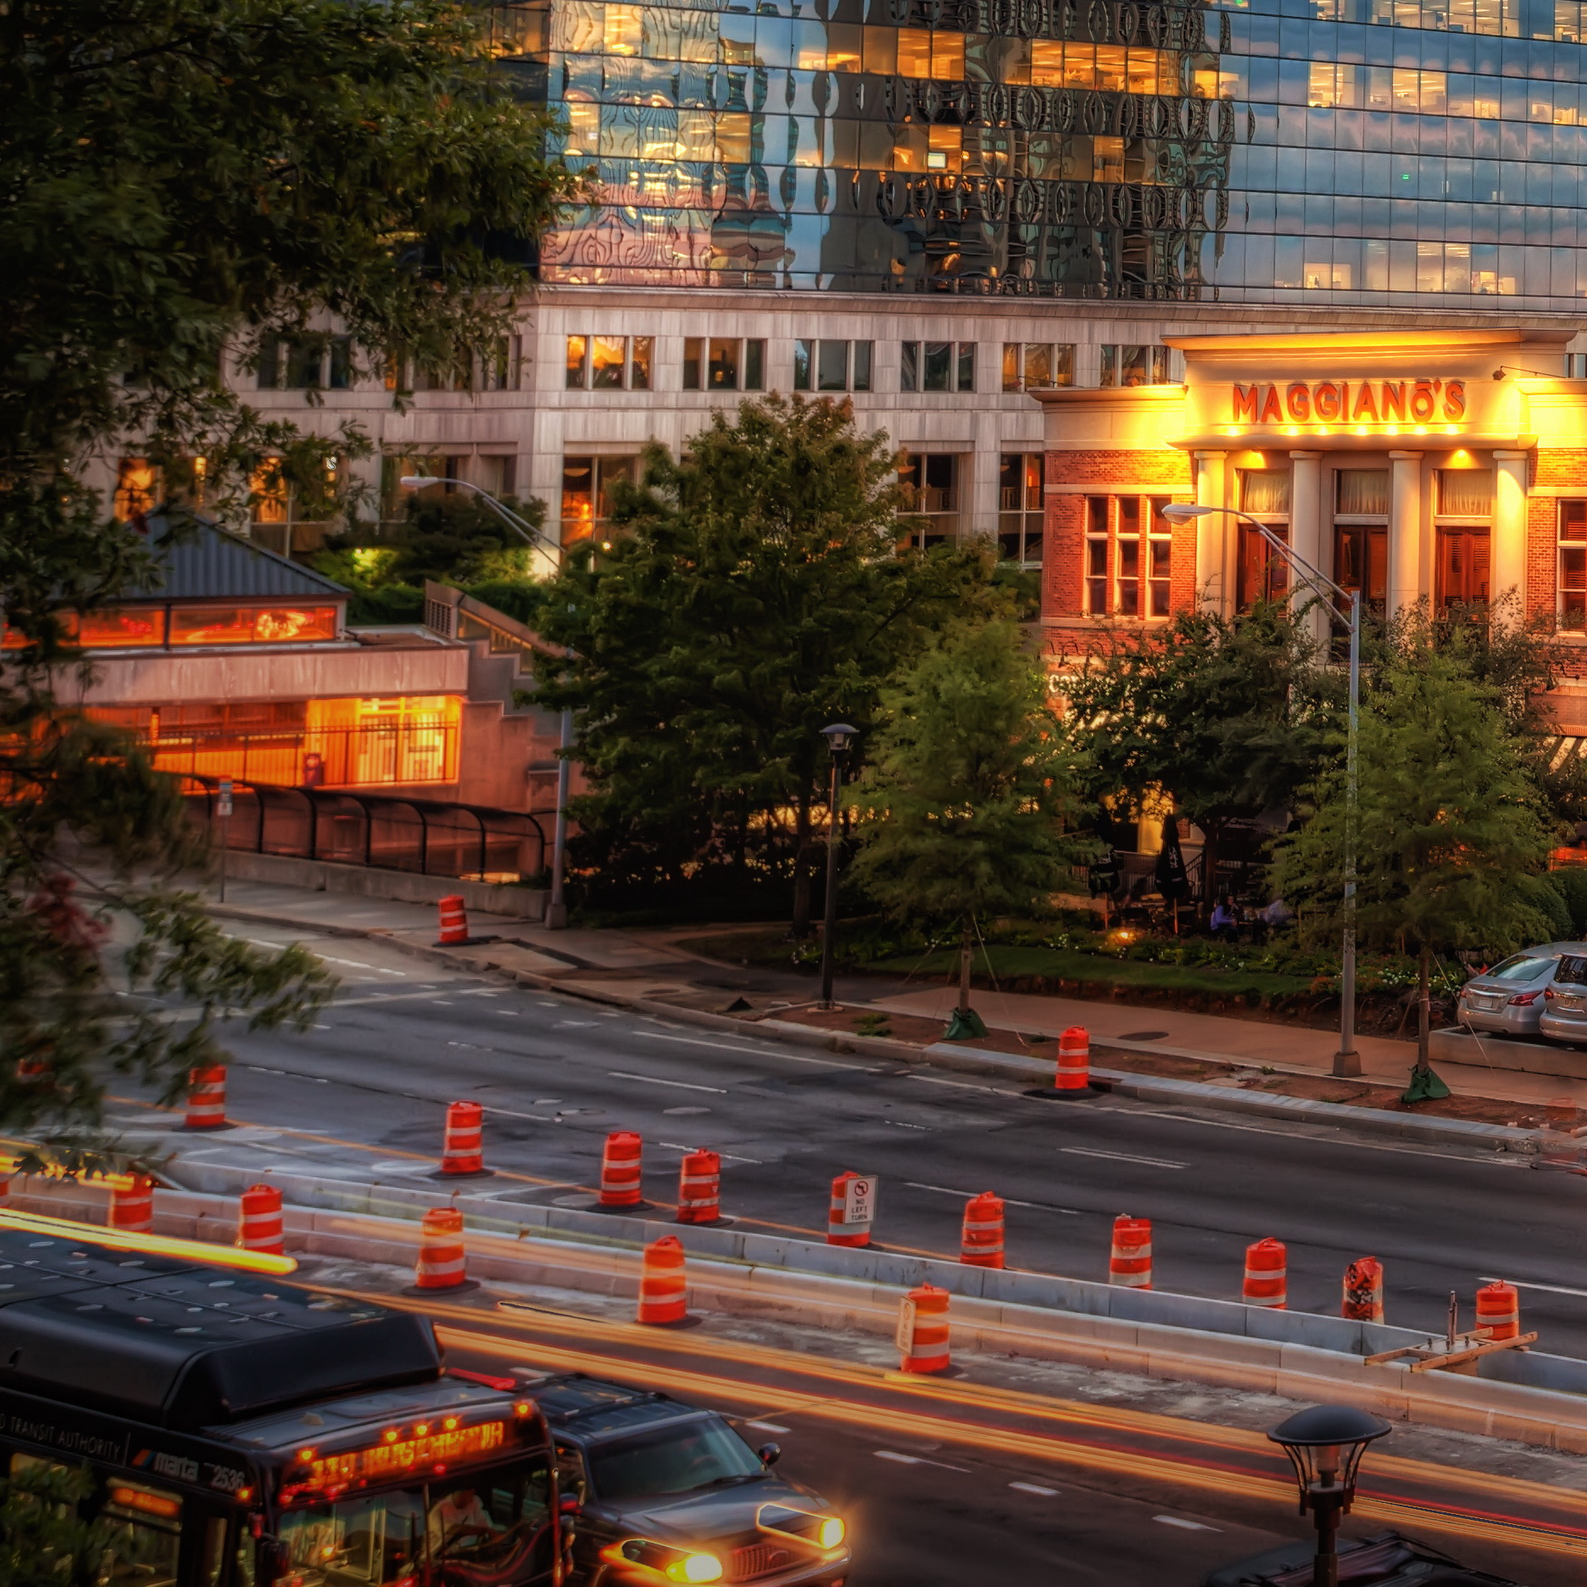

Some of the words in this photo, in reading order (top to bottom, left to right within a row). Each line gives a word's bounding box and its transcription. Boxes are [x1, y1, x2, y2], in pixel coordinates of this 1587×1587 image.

[1233, 381, 1466, 423] MAGGIANO'S
[851, 1206, 868, 1214] LEFT
[9, 1416, 56, 1442] TRANSIT
[58, 1429, 121, 1462] AUTHORITY
[153, 1451, 200, 1483] marta
